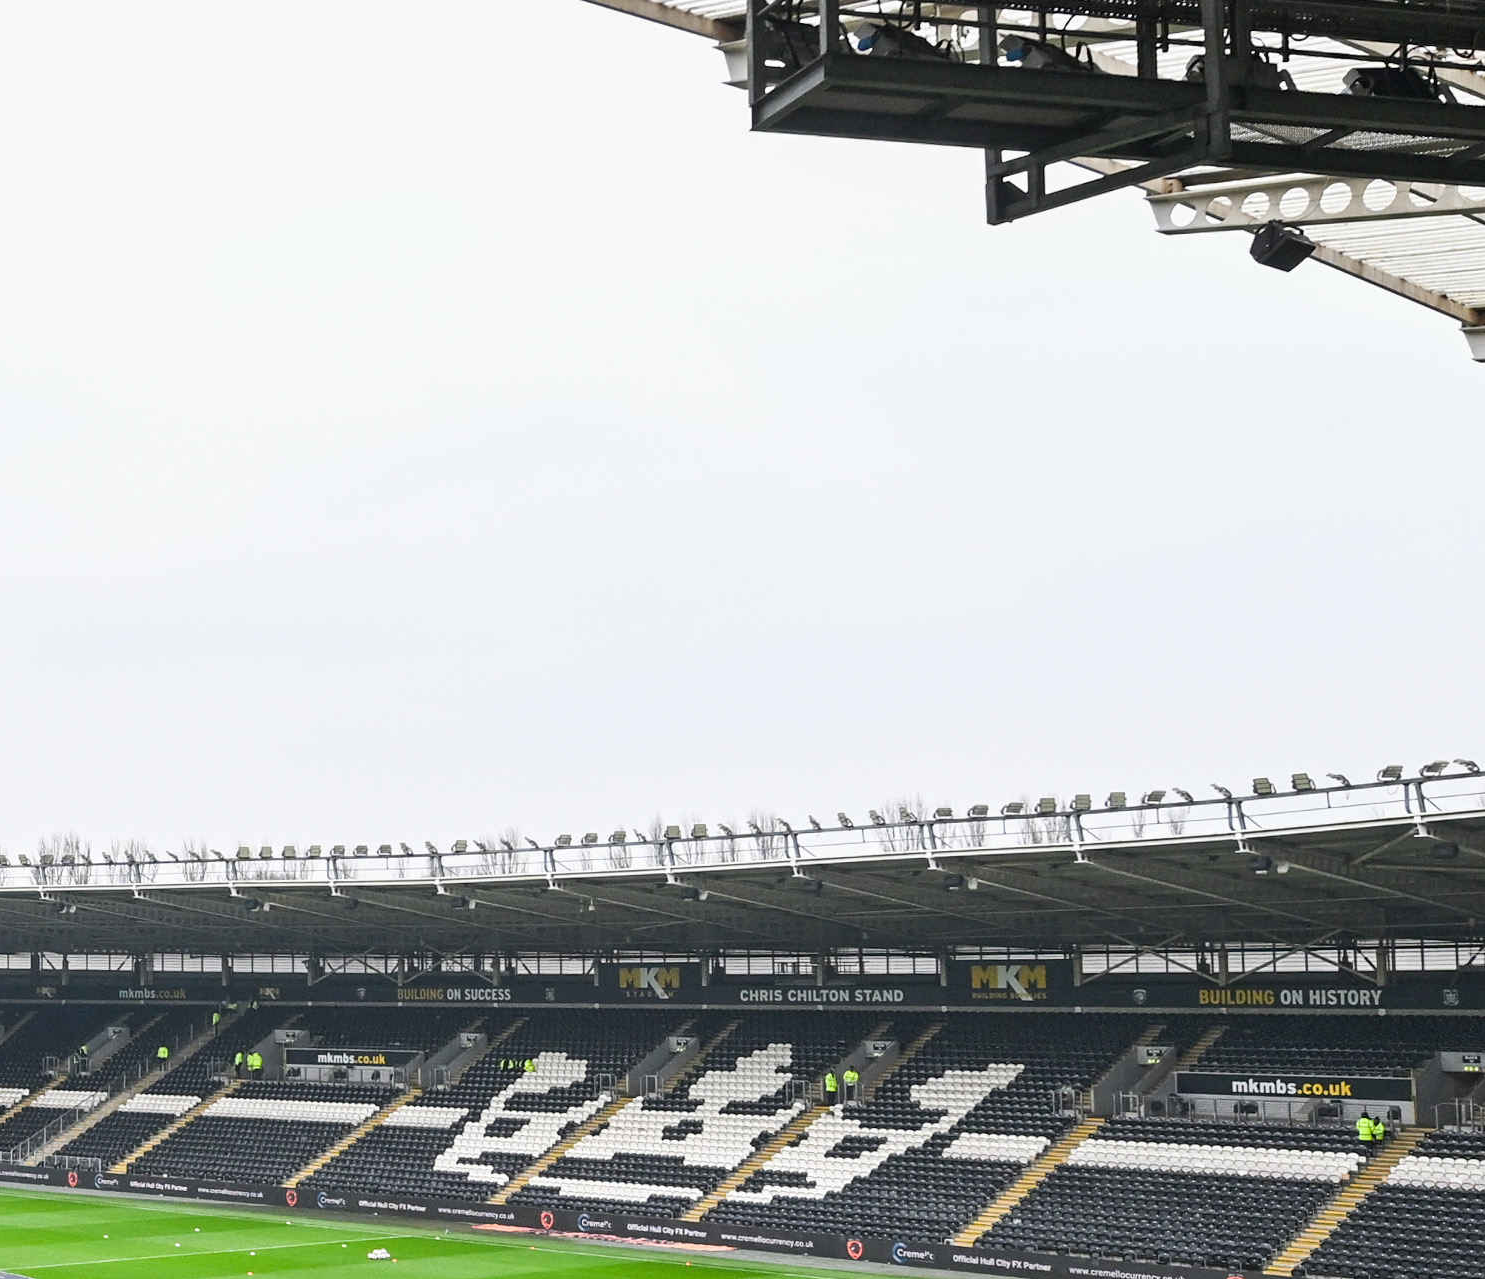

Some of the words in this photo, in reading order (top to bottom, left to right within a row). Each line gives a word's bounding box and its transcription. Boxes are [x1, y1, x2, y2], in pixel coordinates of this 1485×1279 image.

[619, 967, 680, 999] MKM
[971, 965, 1046, 1001] MKM
[119, 988, 186, 999] mkmbs.co.uk
[397, 988, 443, 1000] BUILDING
[446, 988, 461, 1000] ON
[464, 989, 511, 1001] SUCCESS
[740, 990, 783, 1002] CHRIS
[788, 990, 851, 1002] CHILTON
[855, 990, 904, 1002] STAND
[1199, 989, 1274, 1005] BUILDING
[1280, 989, 1303, 1005] ON
[1309, 989, 1382, 1006] HISTORY
[317, 1052, 387, 1065] mkmbs.co.uk
[1232, 1078, 1352, 1097] mkmbs.co.uk
[627, 1223, 647, 1232] Official
[663, 1226, 674, 1236] City
[952, 1254, 979, 1265] Official
[980, 1257, 994, 1267] Hull
[996, 1258, 1010, 1269] City
[1012, 1260, 1022, 1269] FX
[1024, 1262, 1051, 1272] Partner
